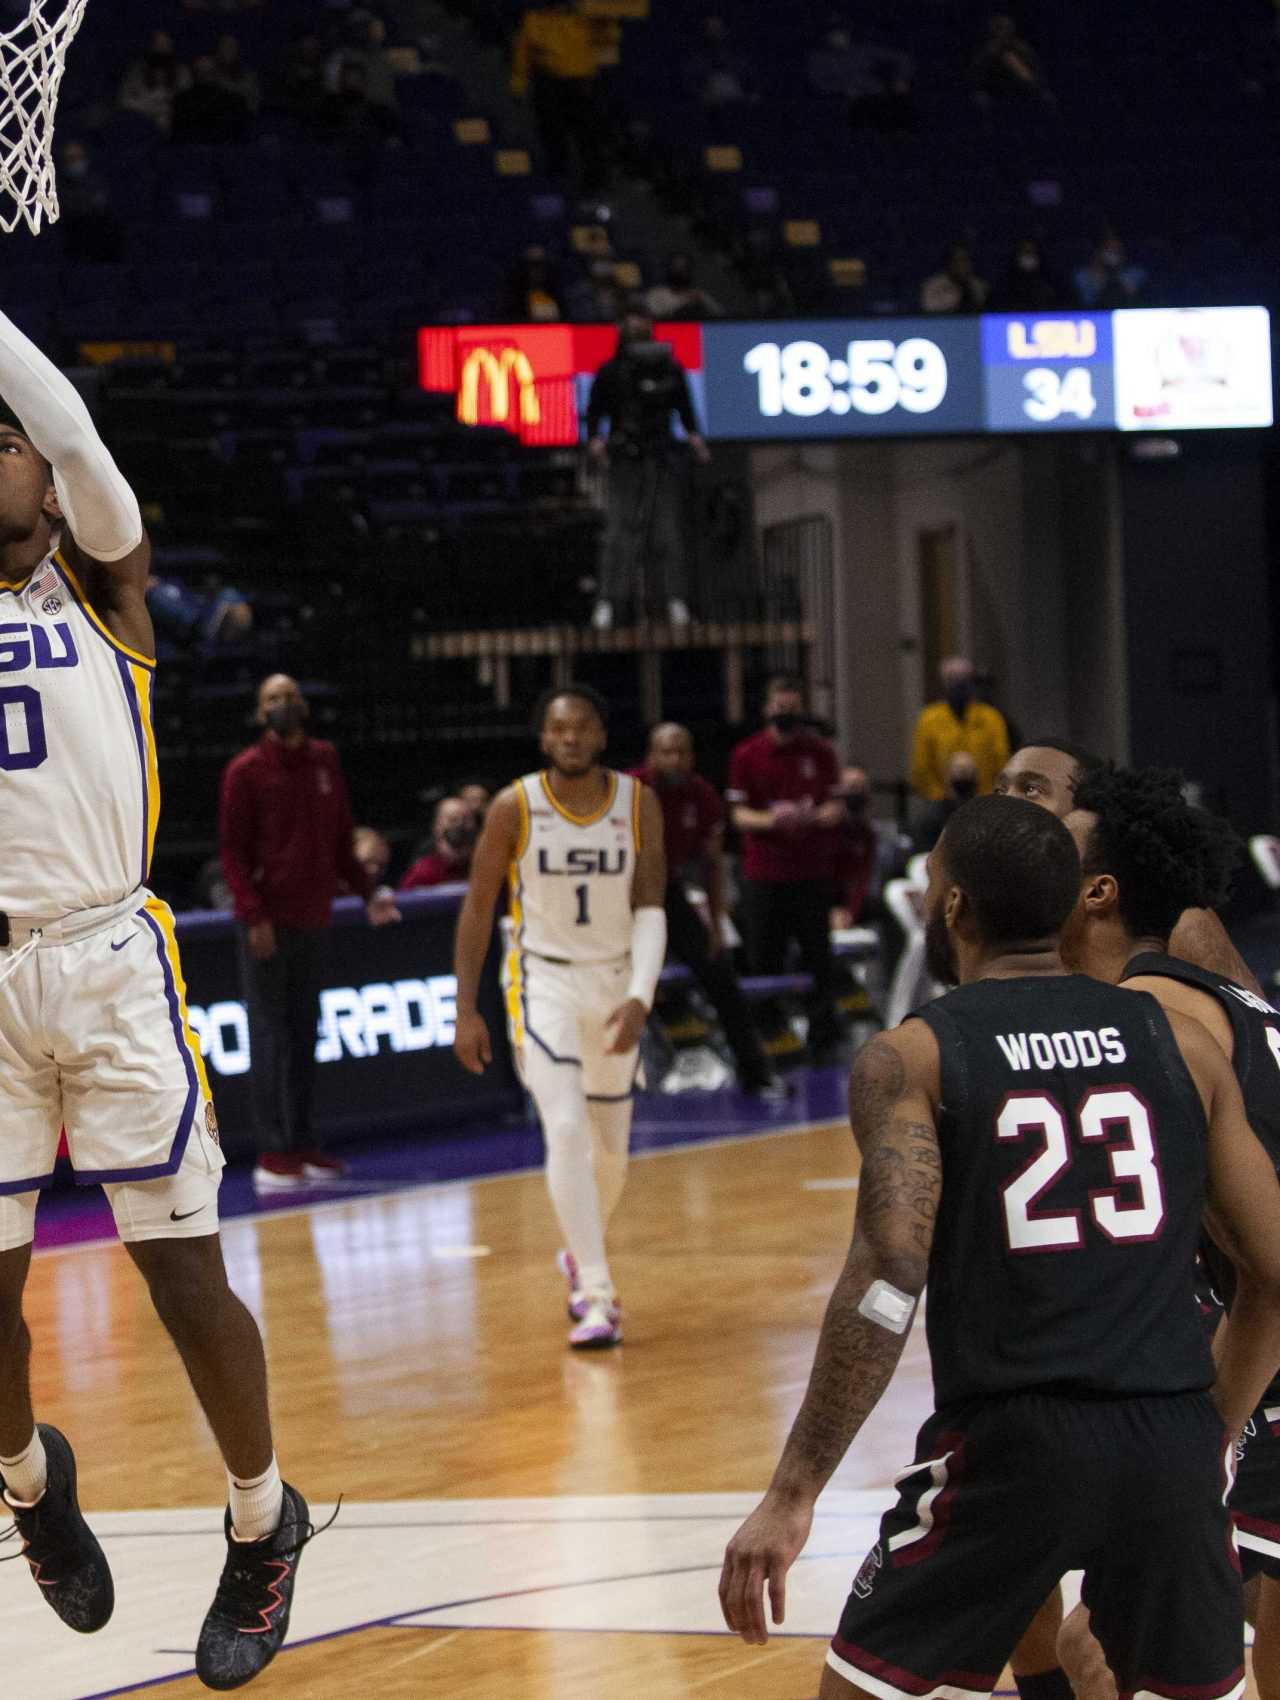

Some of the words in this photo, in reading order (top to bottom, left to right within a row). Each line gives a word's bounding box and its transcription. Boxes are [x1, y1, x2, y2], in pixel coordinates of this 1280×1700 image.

[1006, 320, 1097, 360] LSU
[743, 337, 948, 417] 18:59
[1023, 367, 1097, 422] 34
[539, 848, 627, 875] LSU
[575, 884, 591, 925] 1
[995, 1026, 1127, 1071] WOODS
[993, 1083, 1166, 1254] 23
